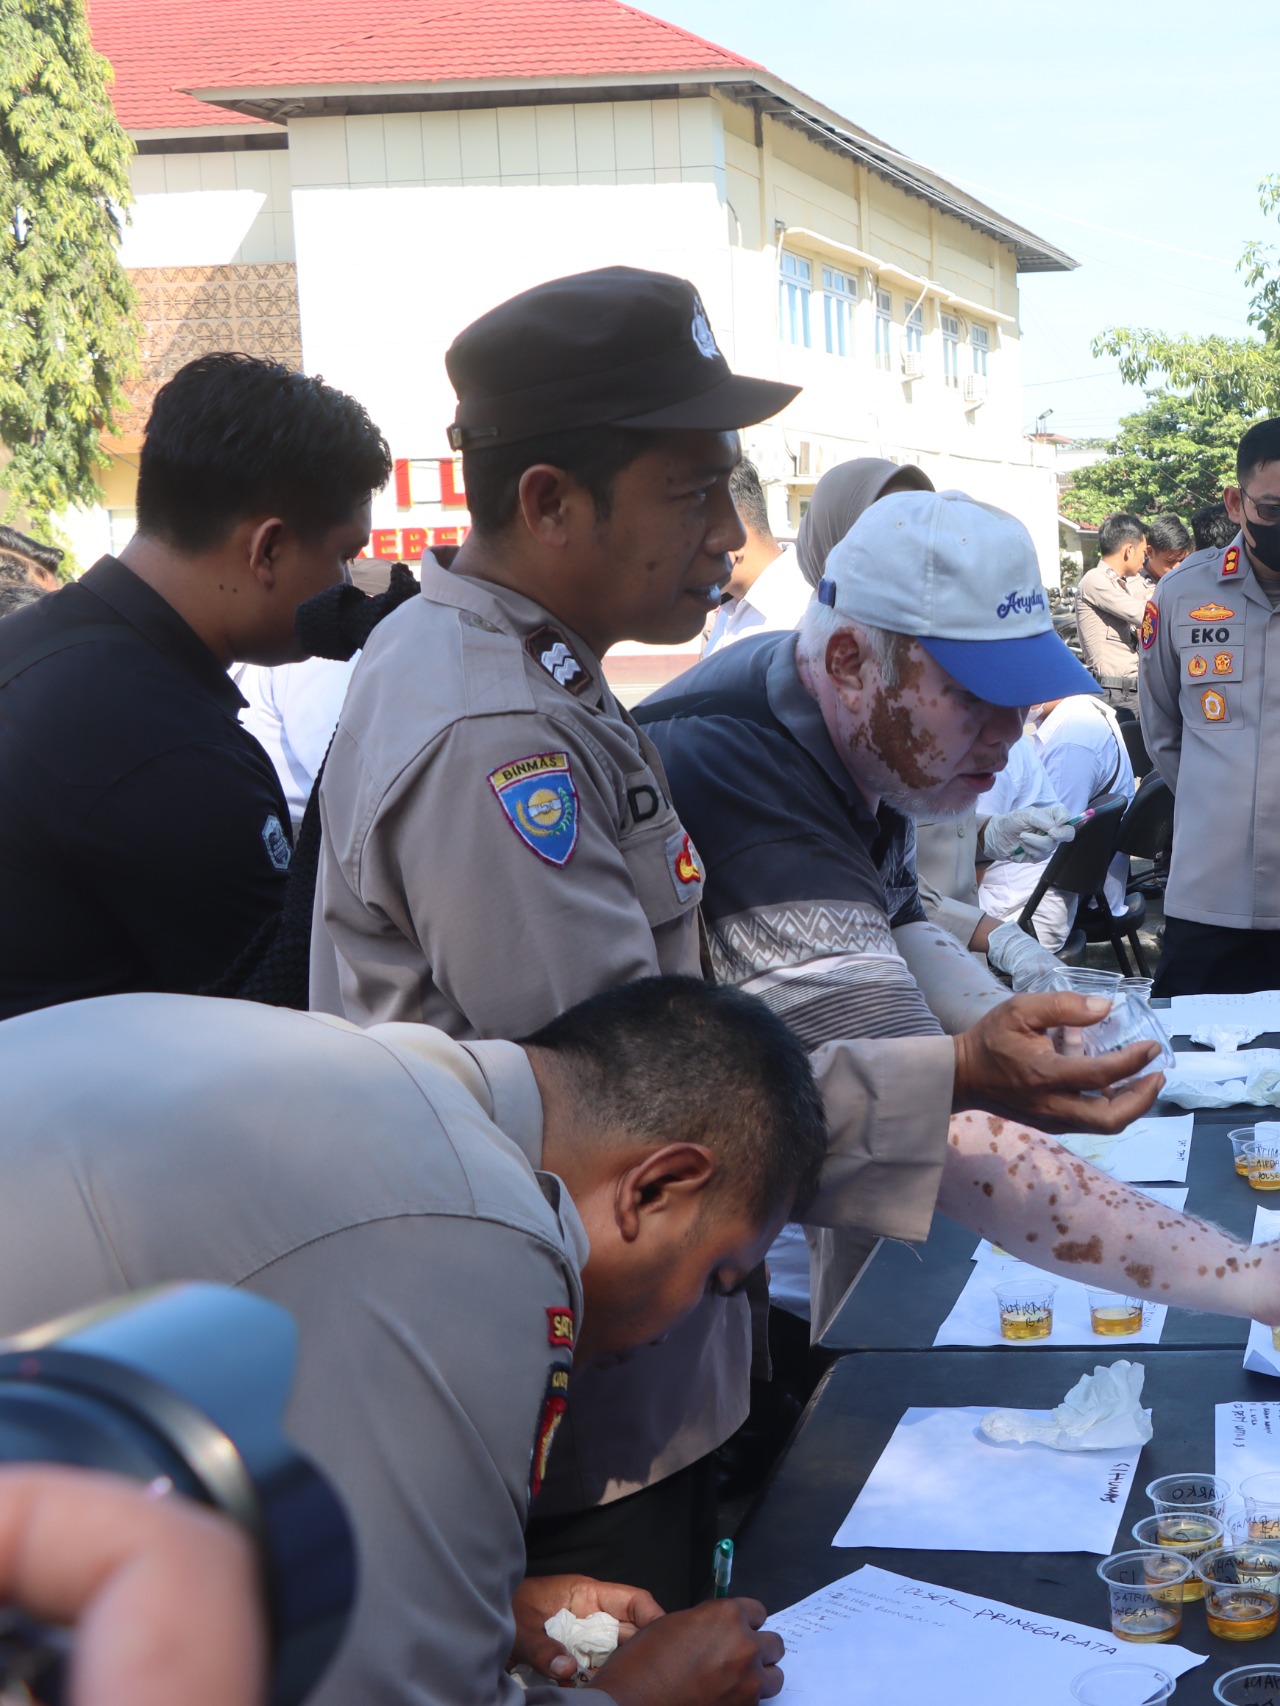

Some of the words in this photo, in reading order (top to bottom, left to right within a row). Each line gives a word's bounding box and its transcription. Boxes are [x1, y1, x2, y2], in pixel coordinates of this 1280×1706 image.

[357, 526, 471, 559] EBE
[1191, 627, 1230, 644] EKO
[502, 756, 558, 781] BINMAS
[1114, 1591, 1154, 1604] SATRIA
[973, 1608, 1117, 1656] PRINGGARATA
